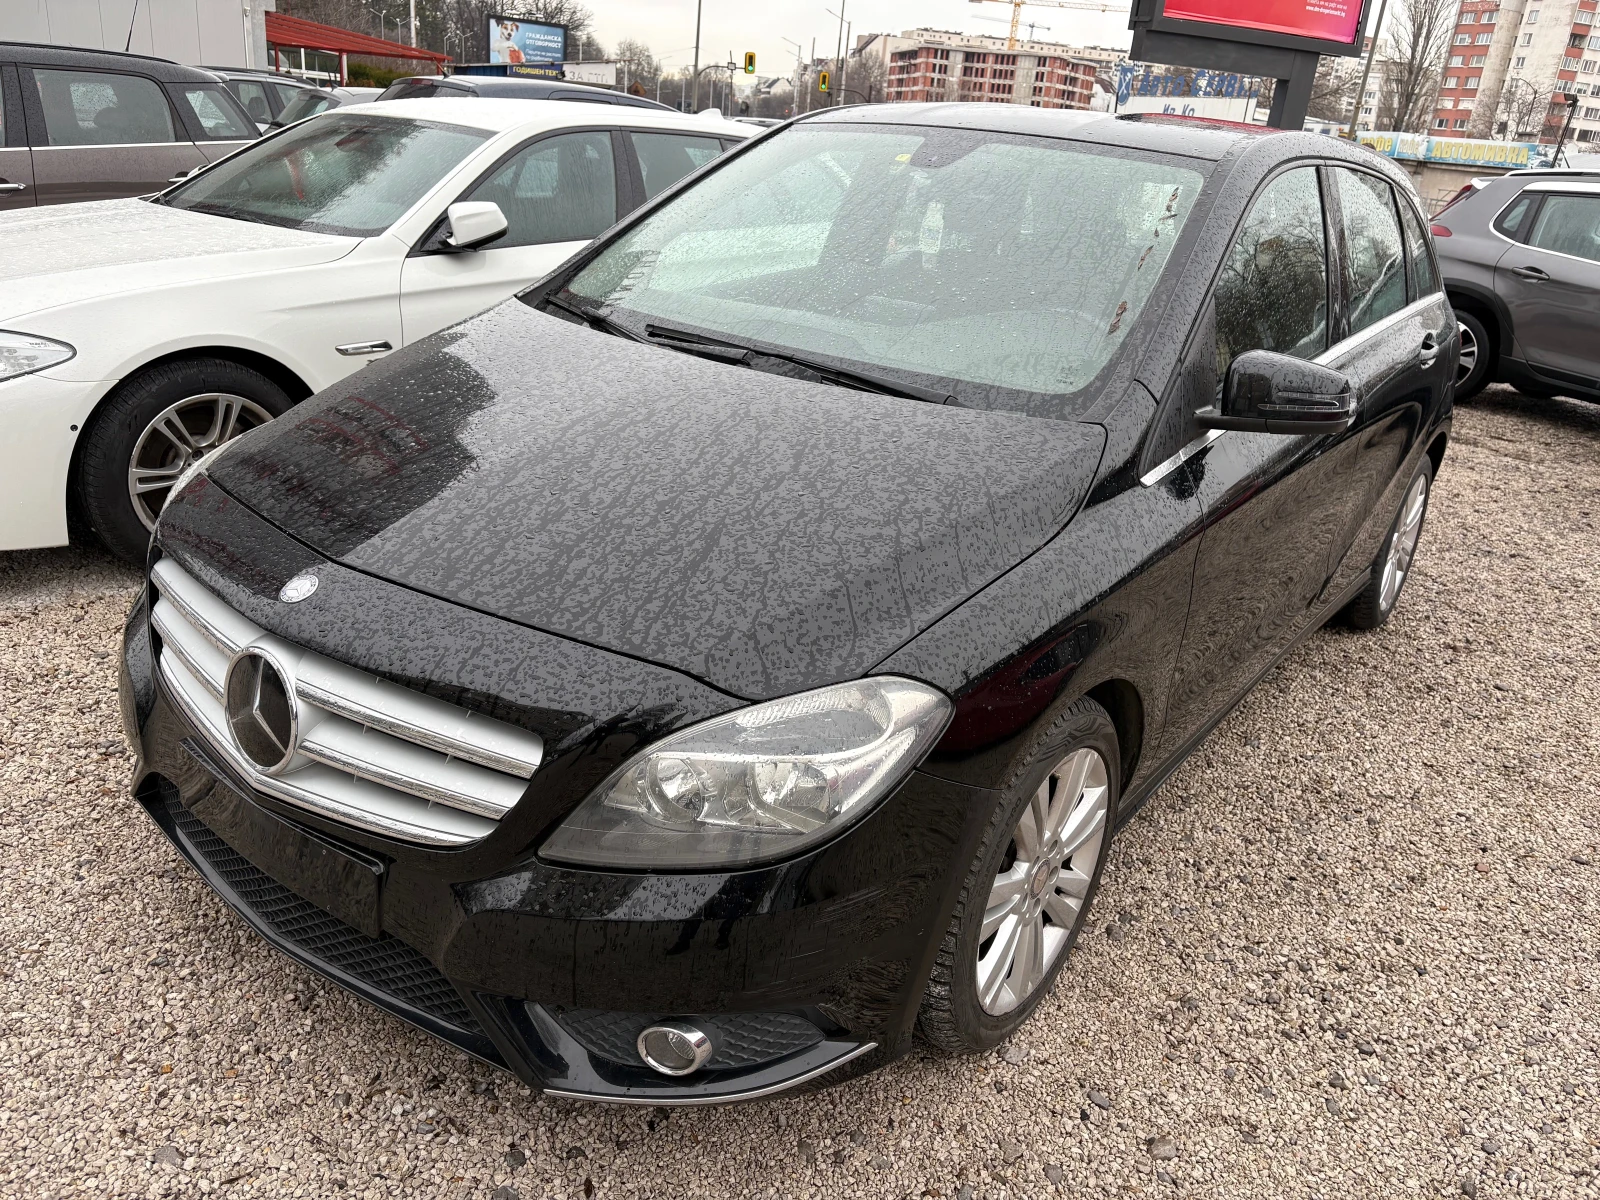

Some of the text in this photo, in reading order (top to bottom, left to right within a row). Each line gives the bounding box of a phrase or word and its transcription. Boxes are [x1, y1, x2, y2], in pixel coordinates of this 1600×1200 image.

[525, 32, 562, 42] ГРАЖДАНСКА
[525, 39, 562, 49] ОТГОВОРНОСТ
[513, 66, 543, 76] ГОДИШЕН
[1431, 141, 1529, 165] АВТОМИВКА
